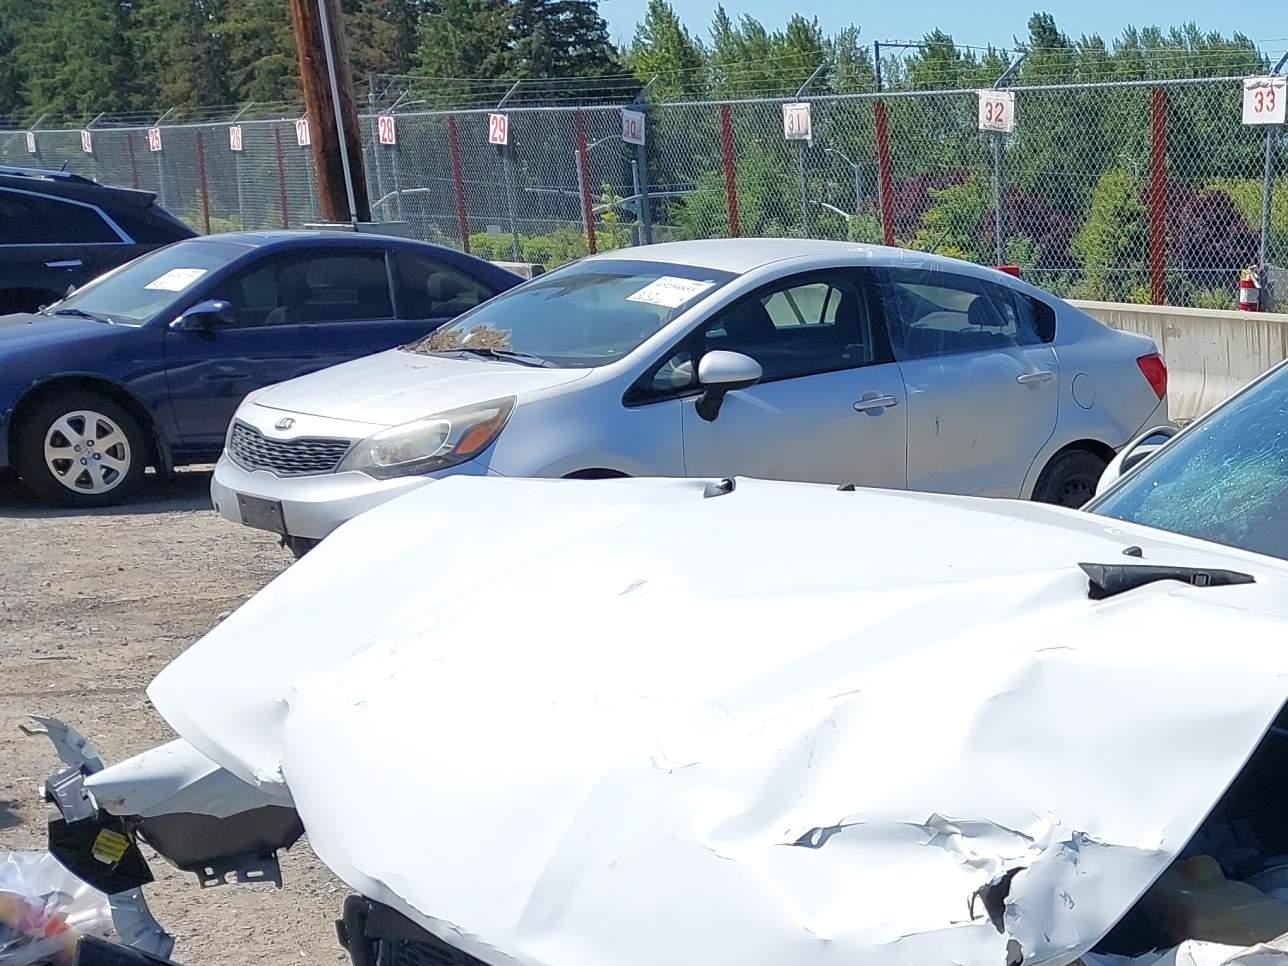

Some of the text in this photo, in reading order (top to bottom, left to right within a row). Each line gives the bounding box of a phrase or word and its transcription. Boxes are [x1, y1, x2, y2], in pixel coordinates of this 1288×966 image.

[1254, 89, 1276, 113] 33
[788, 113, 800, 131] 31
[985, 102, 1005, 122] 32
[231, 128, 241, 149] 26
[297, 121, 308, 143] 27
[380, 118, 394, 142] 28
[491, 116, 506, 142] 29
[625, 119, 637, 137] 30
[150, 130, 160, 149] 25
